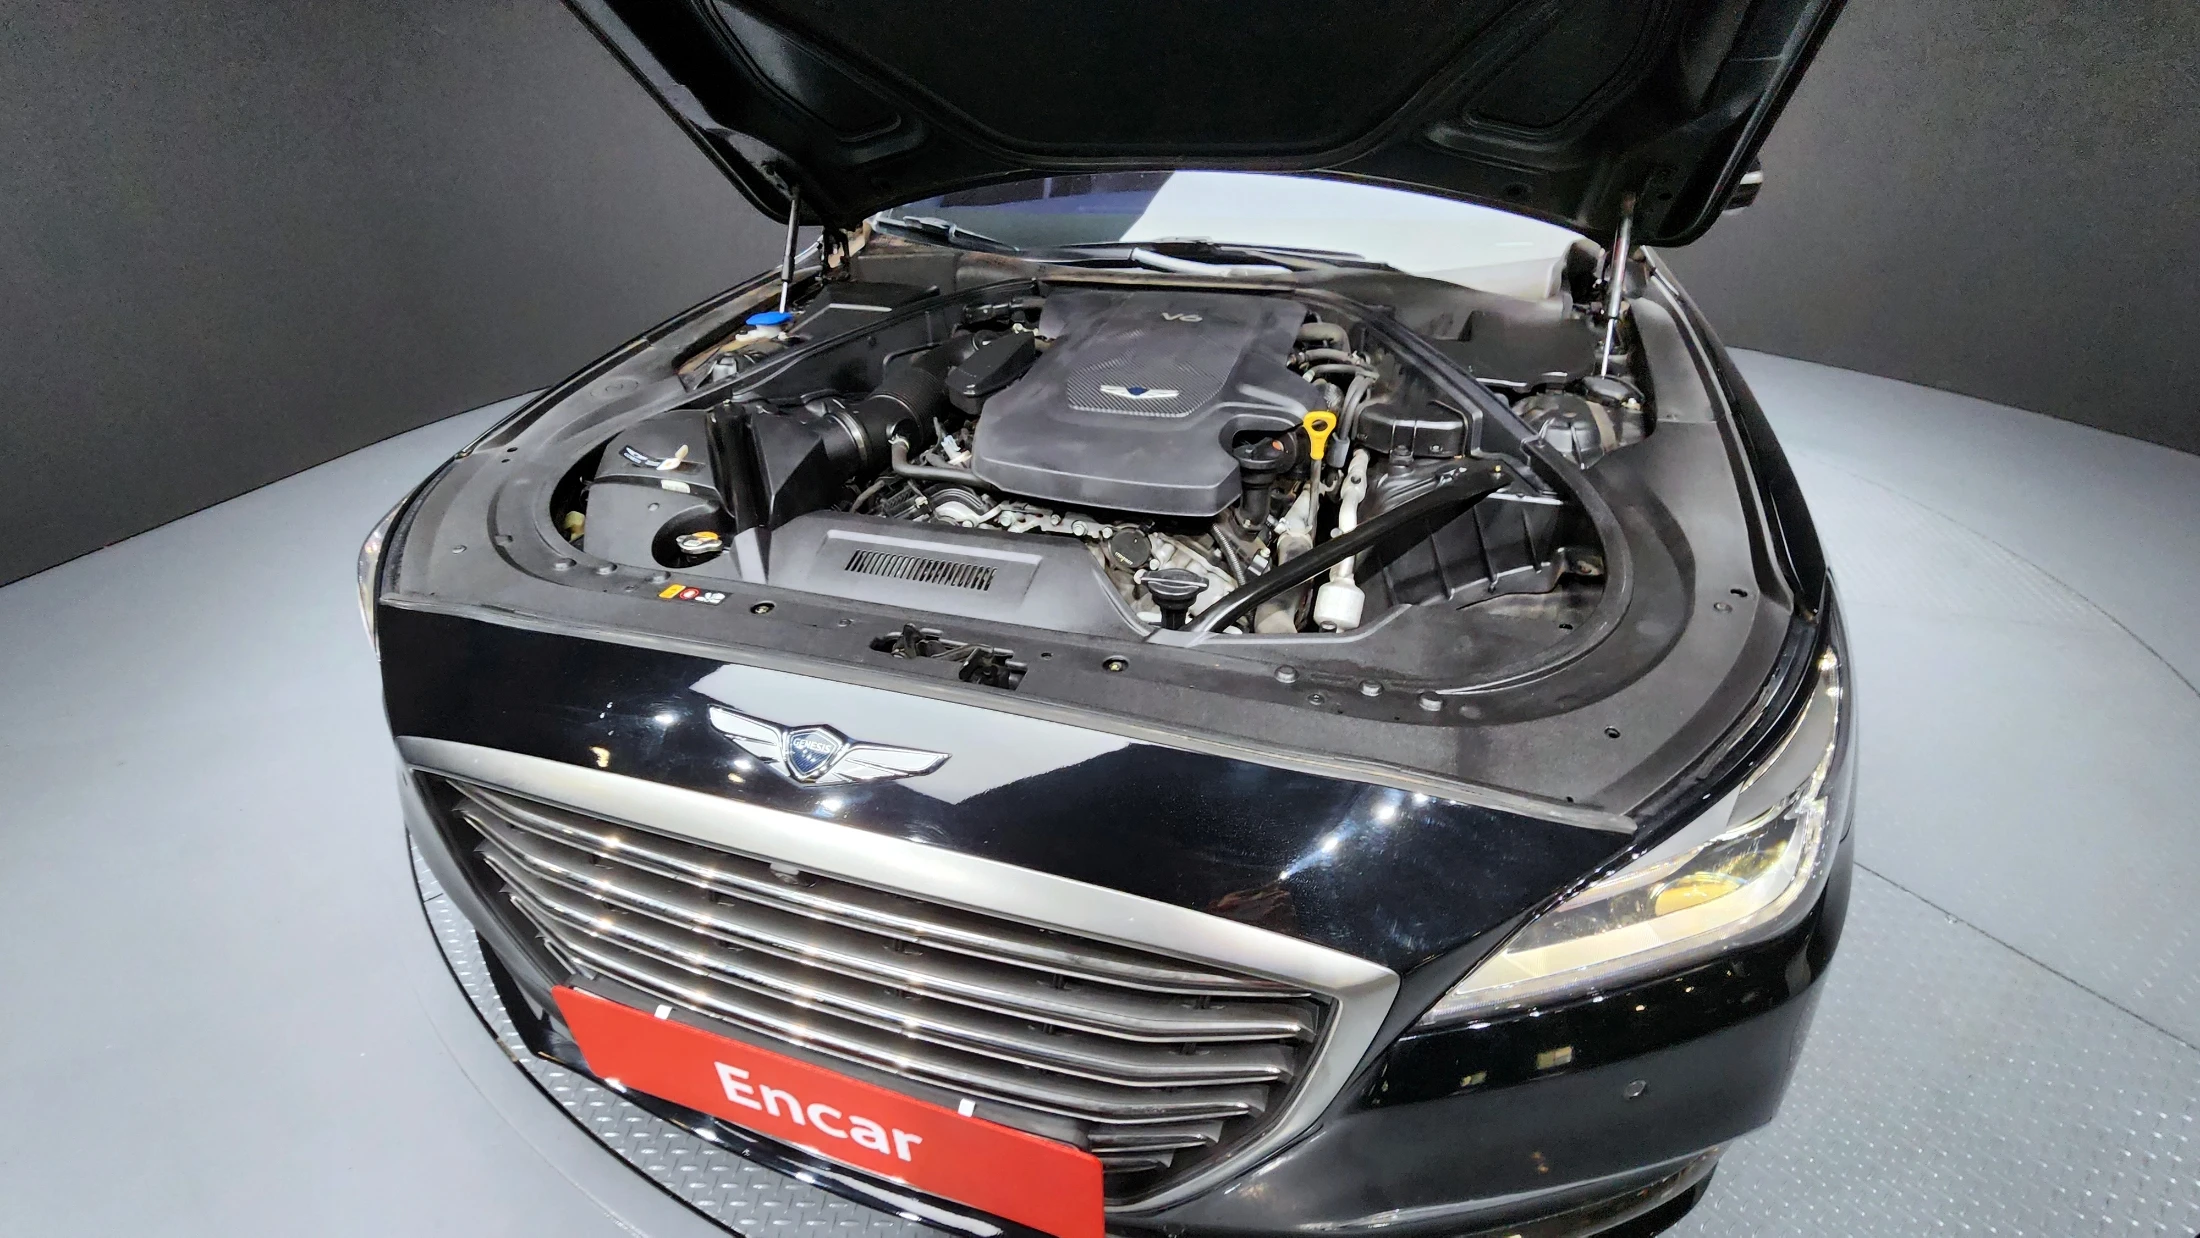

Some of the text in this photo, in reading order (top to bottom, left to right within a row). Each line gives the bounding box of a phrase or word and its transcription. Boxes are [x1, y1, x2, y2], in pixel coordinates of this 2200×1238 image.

[1161, 312, 1203, 322] V6
[792, 737, 831, 753] GENESIS
[714, 1061, 923, 1162] Encar
